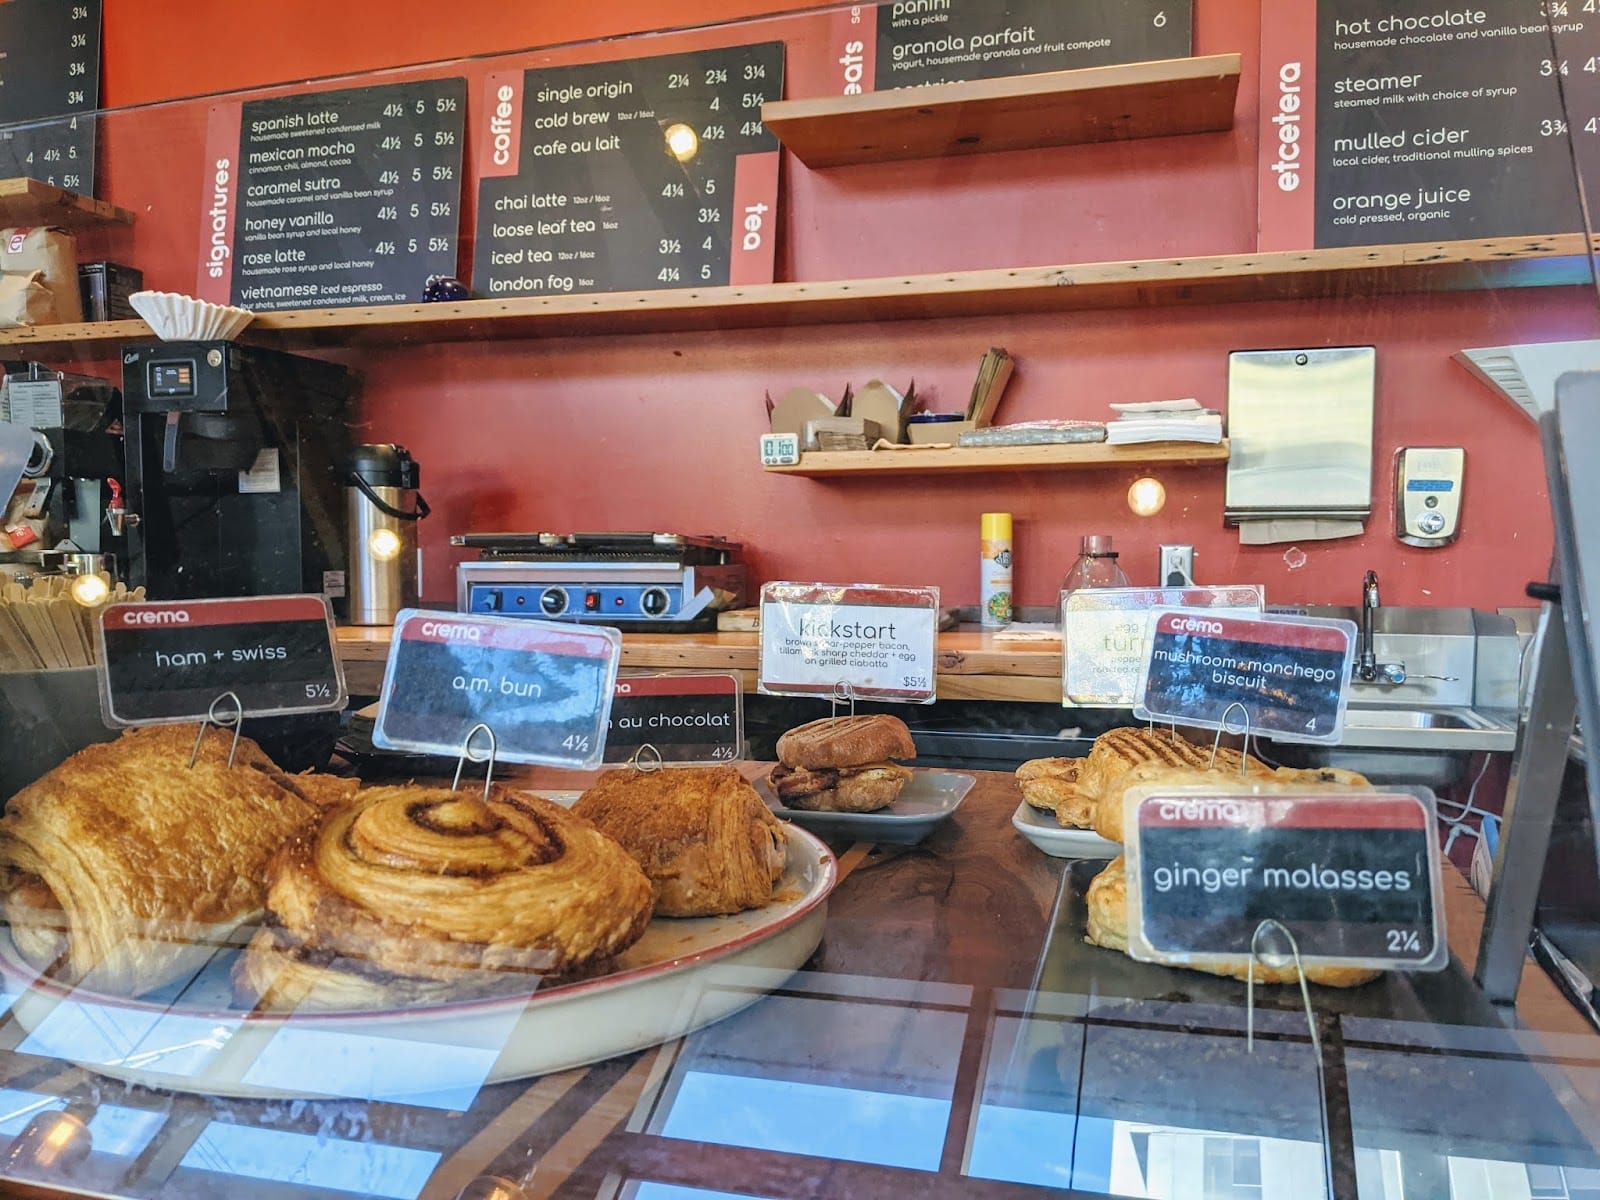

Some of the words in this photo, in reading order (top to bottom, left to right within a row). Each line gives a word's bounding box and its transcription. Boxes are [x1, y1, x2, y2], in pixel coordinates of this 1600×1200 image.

[892, 18, 910, 28] with
[922, 14, 948, 26] pickle
[1153, 11, 1167, 28] 6
[1336, 18, 1371, 36] hot
[1378, 9, 1486, 32] chocolate
[893, 35, 965, 61] granola
[970, 26, 1035, 52] parfait
[1334, 37, 1397, 50] housemade
[1400, 33, 1453, 45] chocolate
[1456, 30, 1478, 40] and
[1480, 27, 1517, 37] vanilla
[1520, 25, 1549, 33] bean
[1552, 23, 1584, 34] syrup
[892, 59, 925, 72] yogurt,
[926, 52, 981, 66] housemade
[983, 48, 1020, 62] granola
[1023, 44, 1042, 55] and
[1044, 42, 1065, 53] fruit
[1067, 38, 1111, 50] compote
[537, 85, 583, 103] single
[587, 80, 633, 99] origin
[668, 74, 690, 89] 2¼
[705, 69, 727, 85] 2¾
[744, 65, 765, 80] 3¼
[1334, 74, 1422, 94] steamer
[1334, 96, 1380, 108] steamed
[1383, 95, 1404, 104] milk
[1407, 93, 1429, 102] with
[1432, 90, 1469, 100] choice
[1472, 88, 1484, 97] of
[1486, 87, 1517, 98] syrup
[252, 114, 304, 134] spanish
[308, 111, 339, 126] latte
[383, 104, 403, 117] 4½
[416, 100, 425, 114] 5
[436, 98, 456, 112] 5½
[535, 112, 568, 129] cold
[573, 112, 610, 126] brew
[710, 97, 720, 111] 4
[742, 93, 764, 108] 5½
[70, 117, 77, 131] 4
[491, 85, 513, 166] coffee
[1272, 62, 1301, 192] etcetera
[249, 148, 304, 164] mexican
[308, 141, 355, 157] mocha
[382, 136, 401, 150] 4½
[414, 133, 423, 147] 5
[435, 132, 455, 145] 5½
[534, 140, 567, 156] cafe
[571, 141, 591, 153] au
[596, 135, 620, 151] lait
[702, 125, 725, 140] 4½
[740, 122, 762, 136] 4¾
[1335, 130, 1406, 152] mulled
[1413, 128, 1469, 146] cider
[27, 152, 34, 164] 4
[44, 150, 60, 162] 4½
[69, 147, 76, 159] 5
[1333, 156, 1359, 167] local
[1361, 154, 1391, 165] cider,
[1393, 151, 1451, 162] traditional
[1454, 148, 1495, 159] mulling
[1498, 145, 1534, 157] spices
[64, 175, 80, 188] 5½
[247, 179, 302, 197] caramel
[305, 177, 341, 192] sutra
[379, 171, 399, 184] 4½
[412, 168, 421, 182] 5
[433, 166, 453, 180] 5½
[495, 195, 528, 211] chai
[532, 194, 567, 208] latte
[662, 184, 684, 198] 4¼
[705, 180, 715, 195] 5
[1333, 193, 1411, 211] orange
[1415, 187, 1471, 210] juice
[206, 158, 229, 278] signatures
[245, 217, 286, 232] honey
[289, 211, 334, 227] vanilla
[377, 206, 397, 220] 4½
[410, 204, 419, 218] 5
[431, 202, 451, 216] 5½
[493, 223, 534, 238] loose
[538, 219, 567, 235] leaf
[570, 219, 596, 233] tea
[698, 208, 720, 223] 3½
[743, 202, 769, 251] tea
[1333, 214, 1357, 225] cold
[1359, 213, 1405, 225] pressed,
[1408, 209, 1450, 221] organic
[243, 253, 273, 265] rose
[275, 250, 306, 263] latte
[376, 242, 395, 255] 4½
[408, 239, 418, 253] 5
[429, 238, 449, 252] 5½
[492, 249, 524, 265] iced
[528, 249, 553, 263] tea
[659, 240, 681, 254] 3½
[702, 236, 712, 250] 4
[490, 276, 543, 292] london
[548, 275, 574, 291] fog
[658, 268, 680, 282] 4¼
[701, 265, 711, 279] 5
[241, 284, 318, 299] vietnamese
[321, 284, 340, 294] iced
[342, 282, 383, 294] espresso
[276, 299, 312, 308] sweetened
[313, 296, 352, 305] condensed
[124, 611, 190, 625] crema
[799, 618, 896, 640] kickstart
[1171, 618, 1223, 634] crema
[421, 620, 480, 640] crema
[156, 651, 207, 668] ham
[214, 650, 224, 660] +
[232, 644, 287, 662] swiss
[822, 649, 848, 660] sharp
[850, 650, 889, 660] cheddar
[899, 653, 916, 662] egg
[879, 642, 911, 652] bacon,
[819, 658, 847, 667] grilled
[850, 659, 888, 668] ciabatta
[1154, 649, 1236, 668] mushroom
[1248, 662, 1336, 682] manchego
[452, 676, 492, 694] a.m.
[501, 677, 542, 698] bun
[903, 676, 927, 688] $5½
[1212, 670, 1267, 689] biscuit
[305, 684, 330, 699] 5½
[619, 717, 643, 729] au
[648, 712, 730, 727] chocolat
[1305, 718, 1316, 732] 4
[562, 734, 589, 752] 4½
[712, 747, 734, 759] 4½
[1160, 802, 1240, 821] crema
[1154, 862, 1253, 893] ginger
[1264, 863, 1411, 891] molasses
[1387, 930, 1420, 953] 2¼
